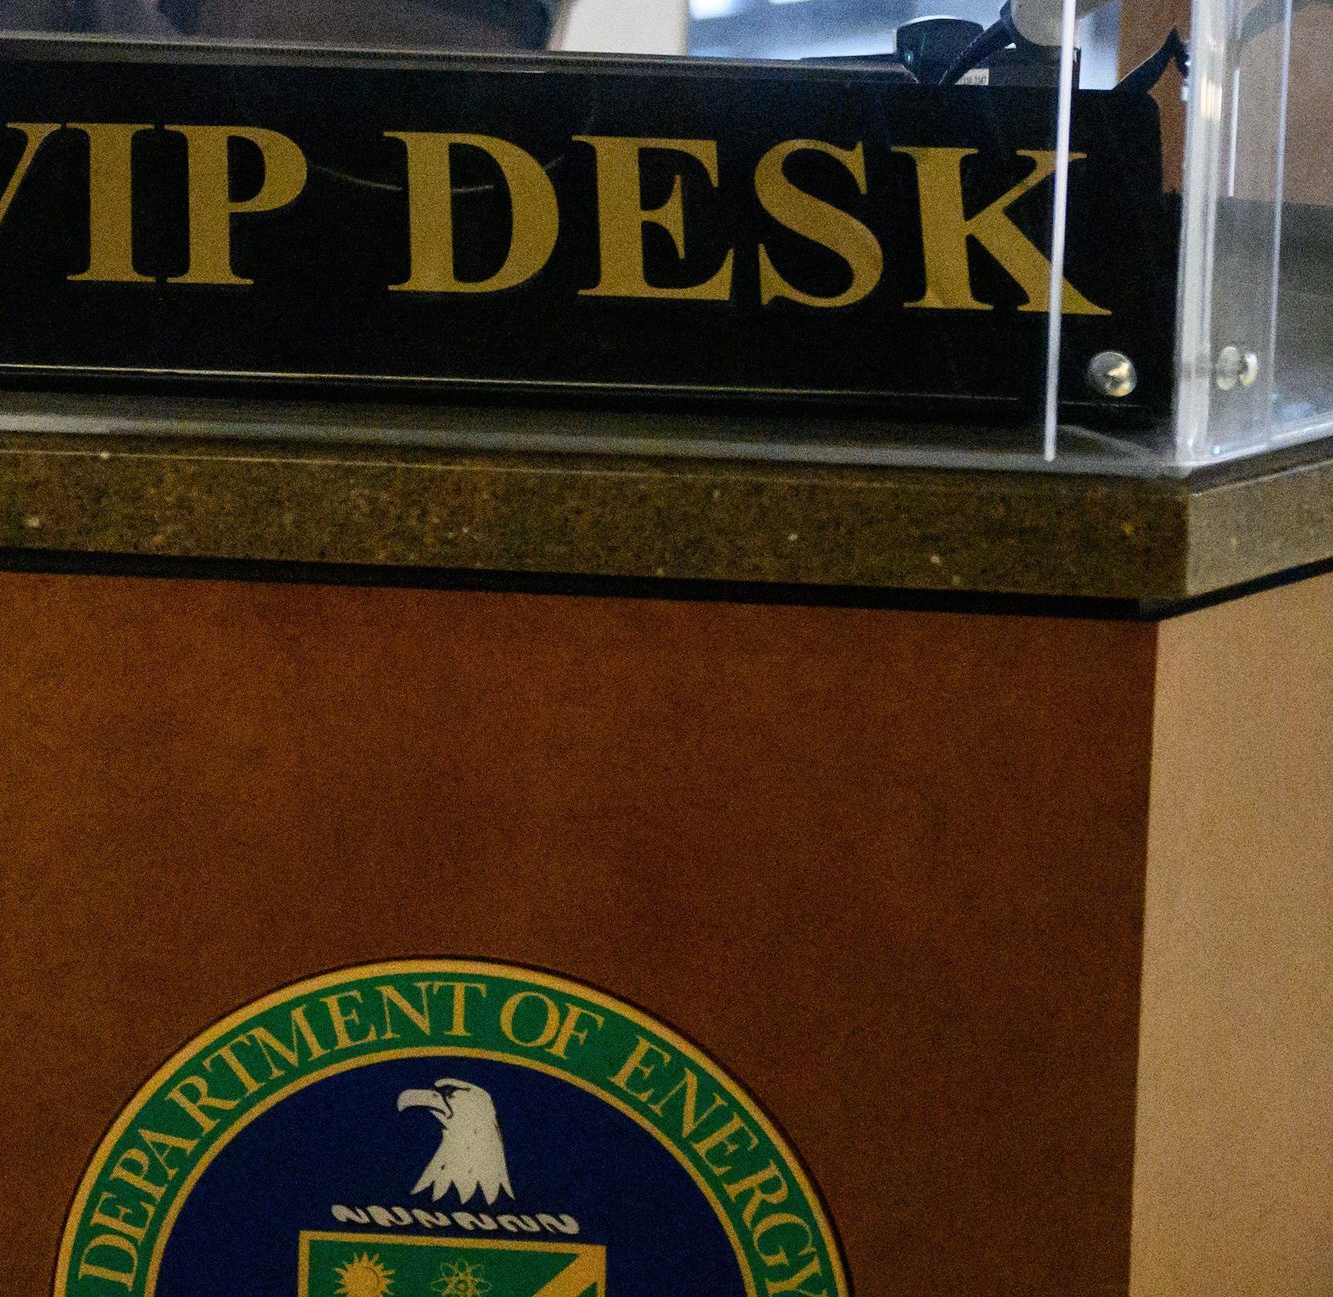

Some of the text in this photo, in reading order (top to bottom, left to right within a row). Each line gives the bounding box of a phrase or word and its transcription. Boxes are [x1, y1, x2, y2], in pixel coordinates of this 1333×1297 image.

[383, 130, 1111, 316] DESK
[78, 981, 827, 1297] DEPARTMENT OF ENERGY
